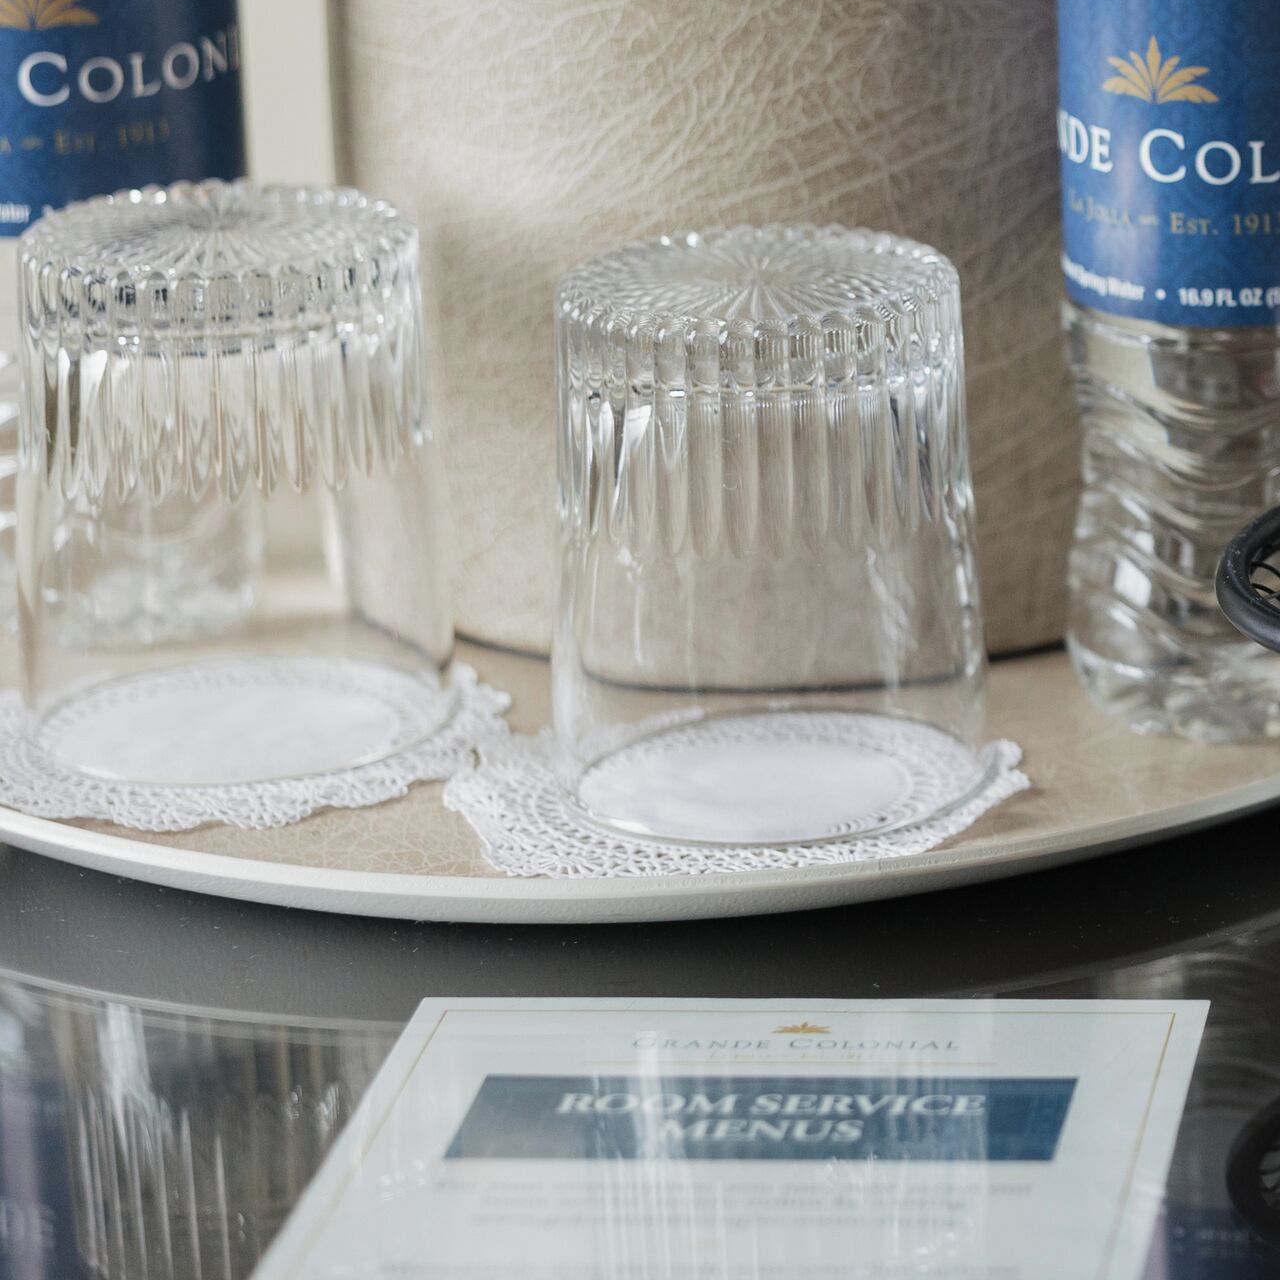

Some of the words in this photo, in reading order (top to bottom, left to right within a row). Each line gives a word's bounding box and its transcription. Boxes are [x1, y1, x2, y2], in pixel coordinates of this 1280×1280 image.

[1178, 286, 1214, 307] 16.9
[1216, 287, 1237, 307] FL
[1239, 287, 1263, 307] OZ
[633, 1037, 771, 1050] GRANDE
[789, 1037, 960, 1051] COLONIAL
[555, 1091, 740, 1116] ROOM
[750, 1091, 987, 1117] SERVICE
[658, 1118, 864, 1143] MENUS
